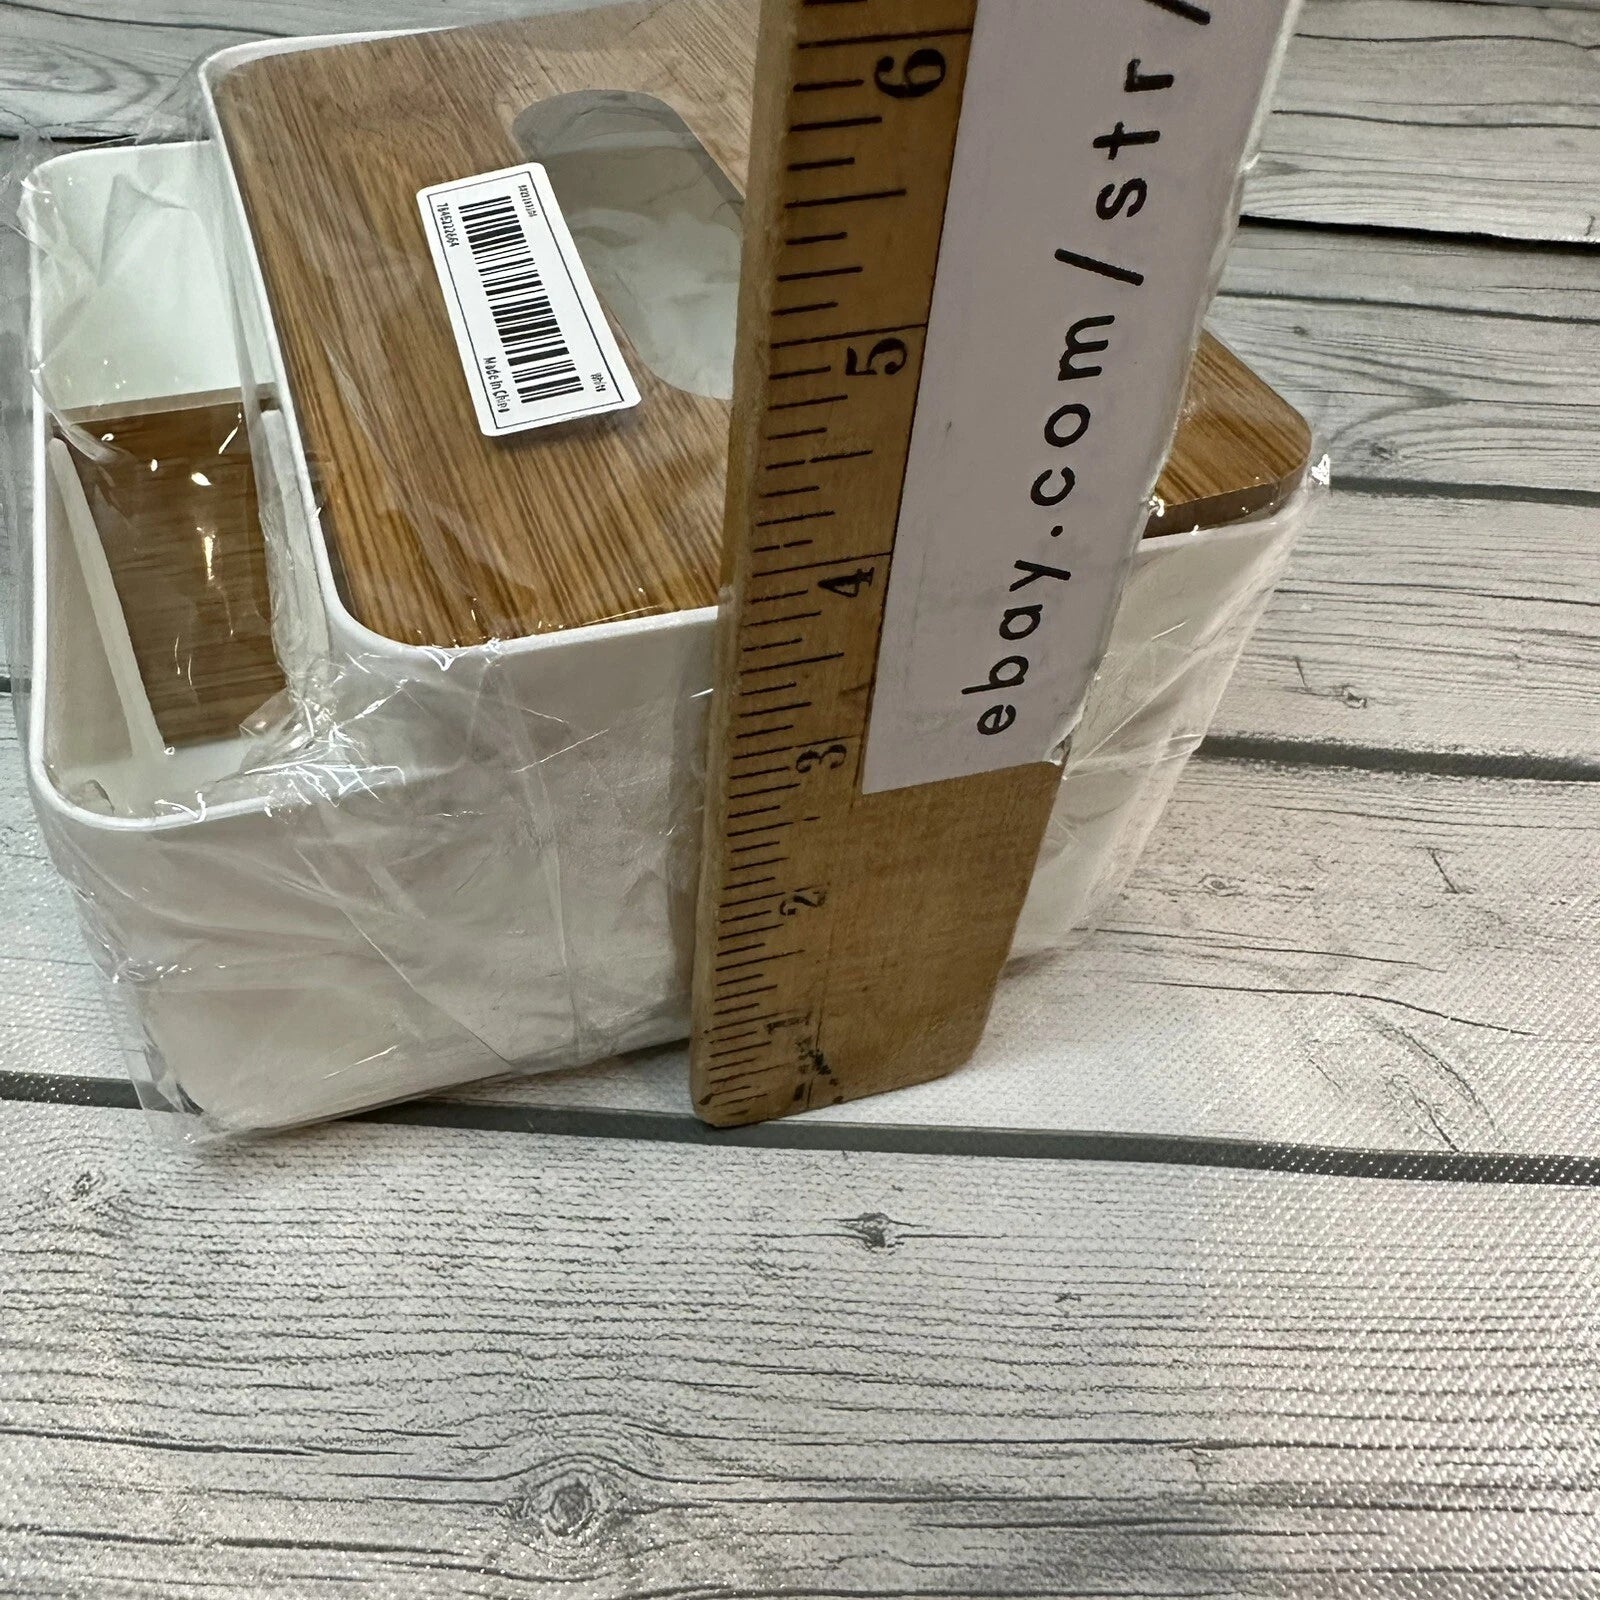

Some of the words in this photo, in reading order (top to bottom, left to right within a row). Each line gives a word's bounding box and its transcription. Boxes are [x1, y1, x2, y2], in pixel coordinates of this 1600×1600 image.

[874, 48, 946, 100] 6
[483, 356, 501, 380] Made
[846, 337, 908, 377] 5
[817, 566, 876, 598] 4
[795, 743, 848, 774] 3
[779, 888, 827, 916] 2
